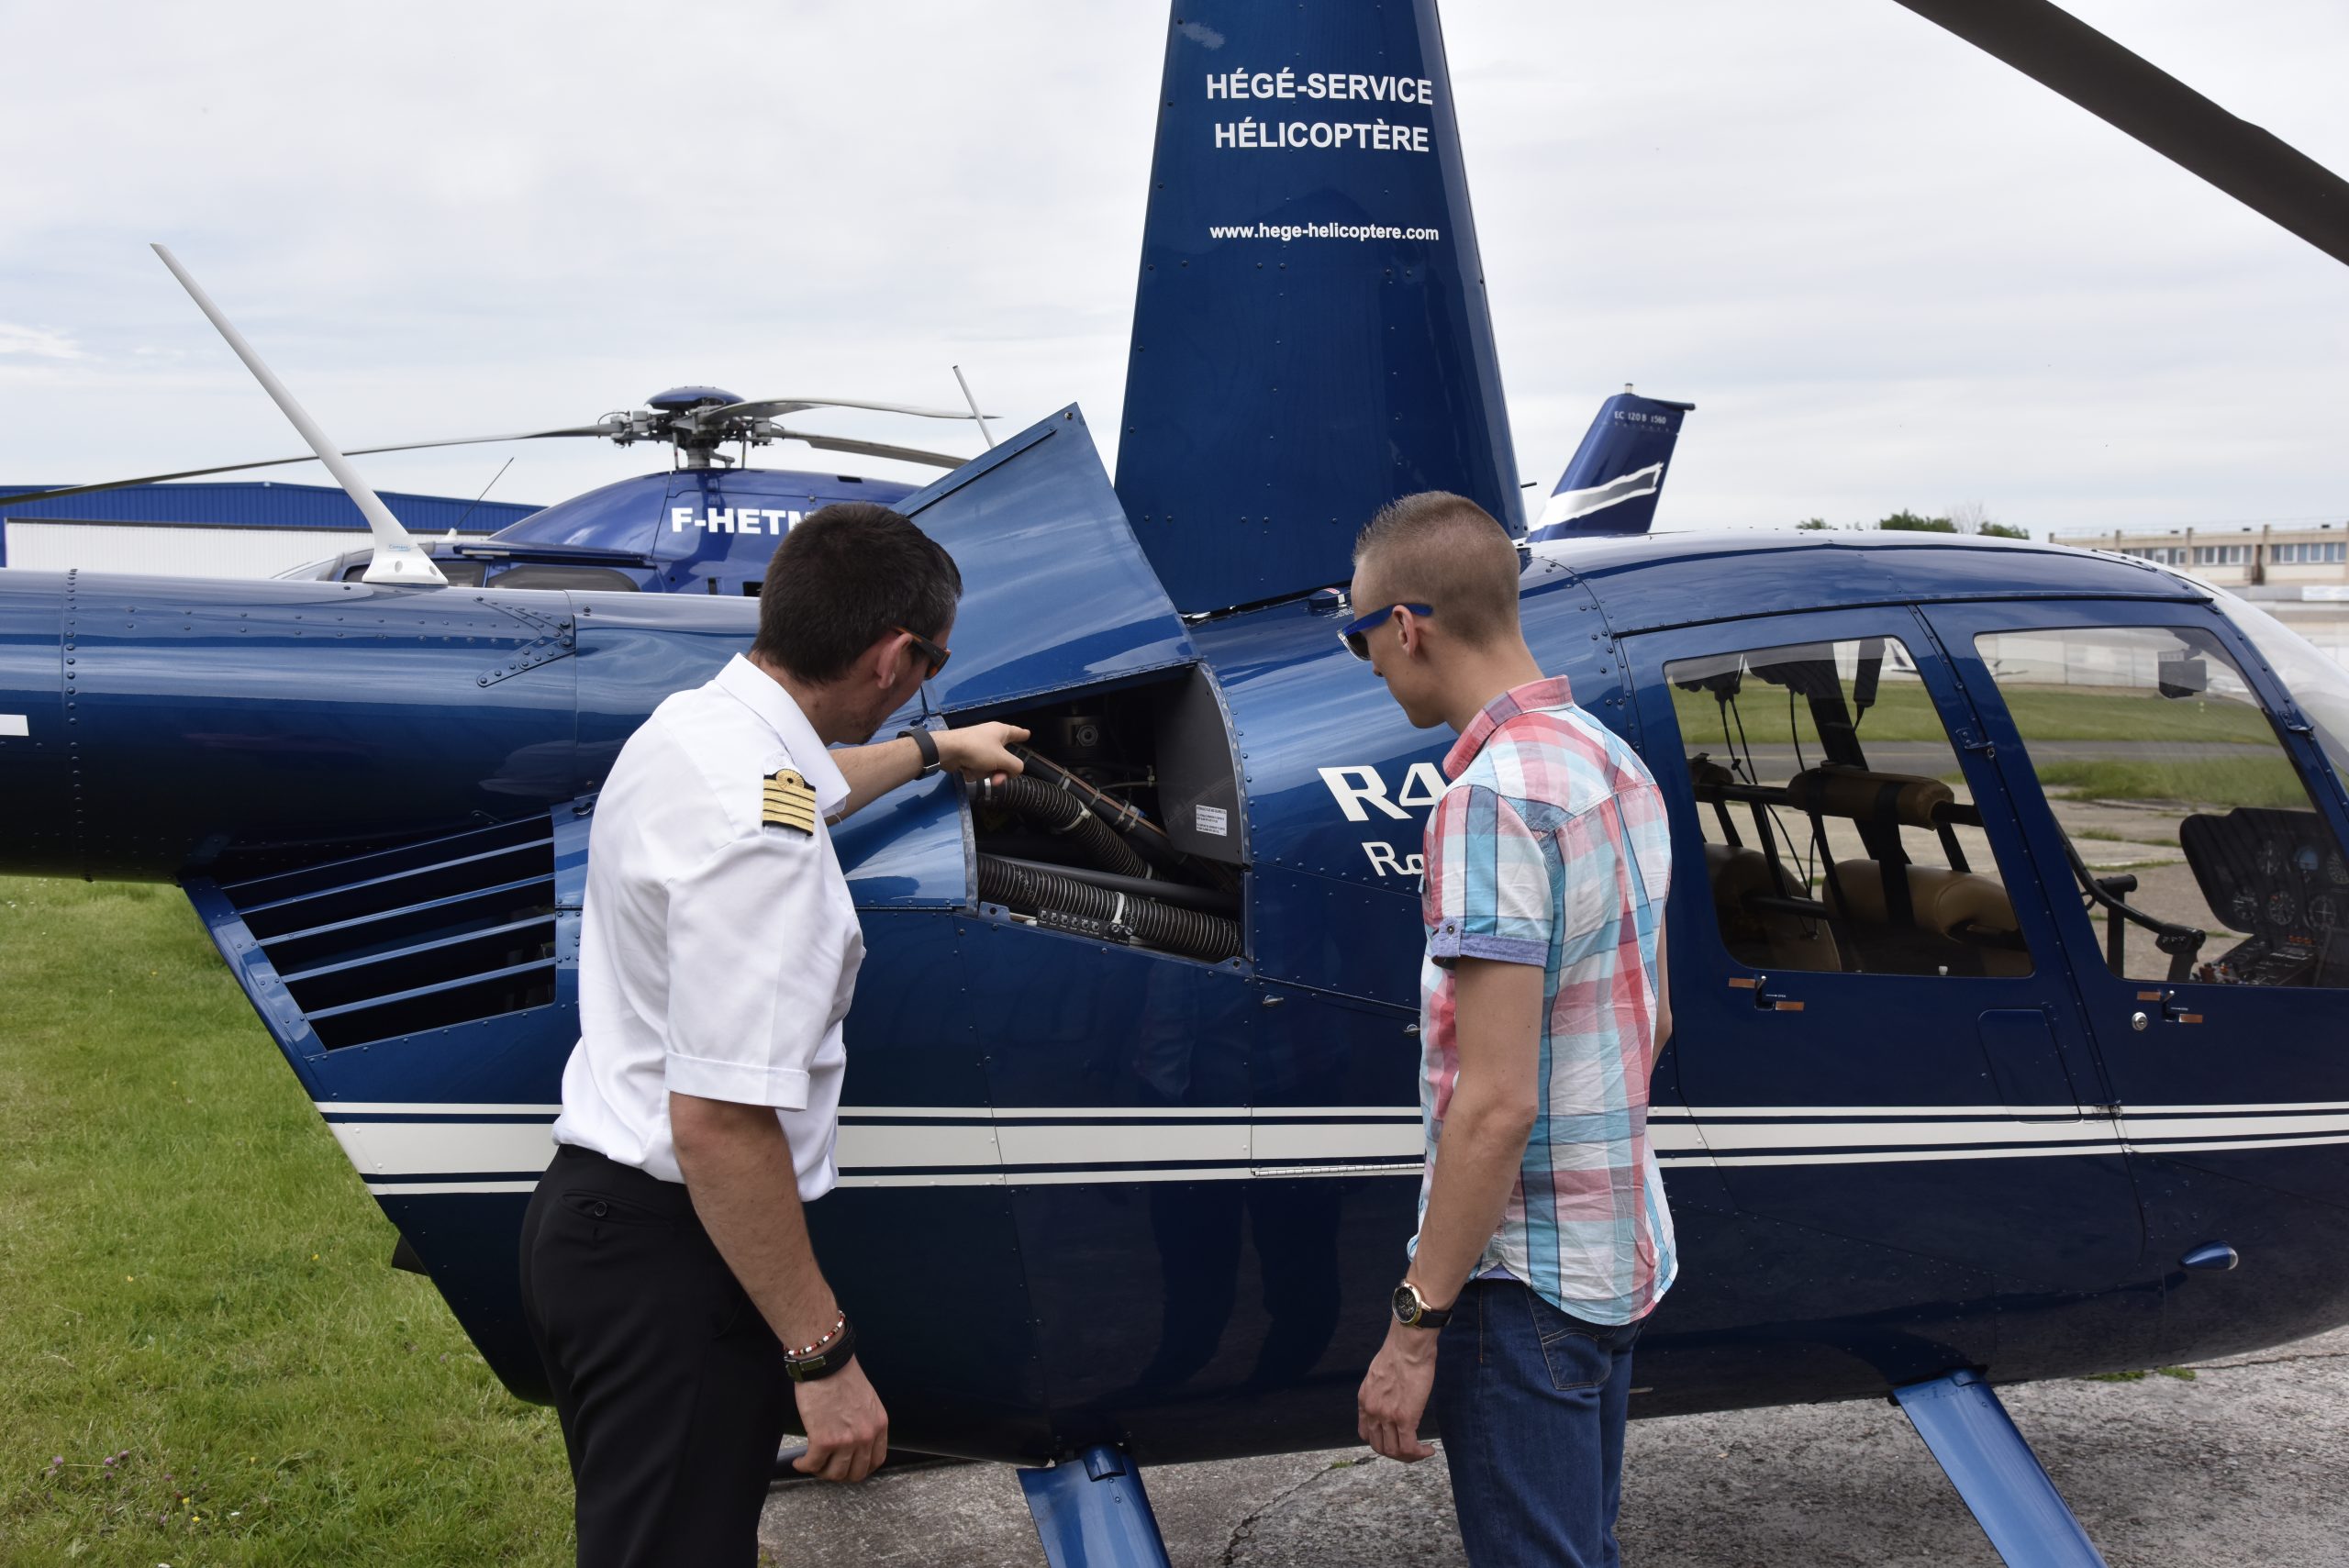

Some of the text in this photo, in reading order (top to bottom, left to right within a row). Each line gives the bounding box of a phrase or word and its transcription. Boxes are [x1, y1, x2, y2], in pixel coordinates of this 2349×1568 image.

[1207, 67, 1433, 106] HÉGÉ-SERVICE
[1215, 117, 1430, 152] HÉLICOPTÈRE
[1209, 222, 1440, 242] www.hege-helicoptere.com
[1614, 410, 1625, 419] EC
